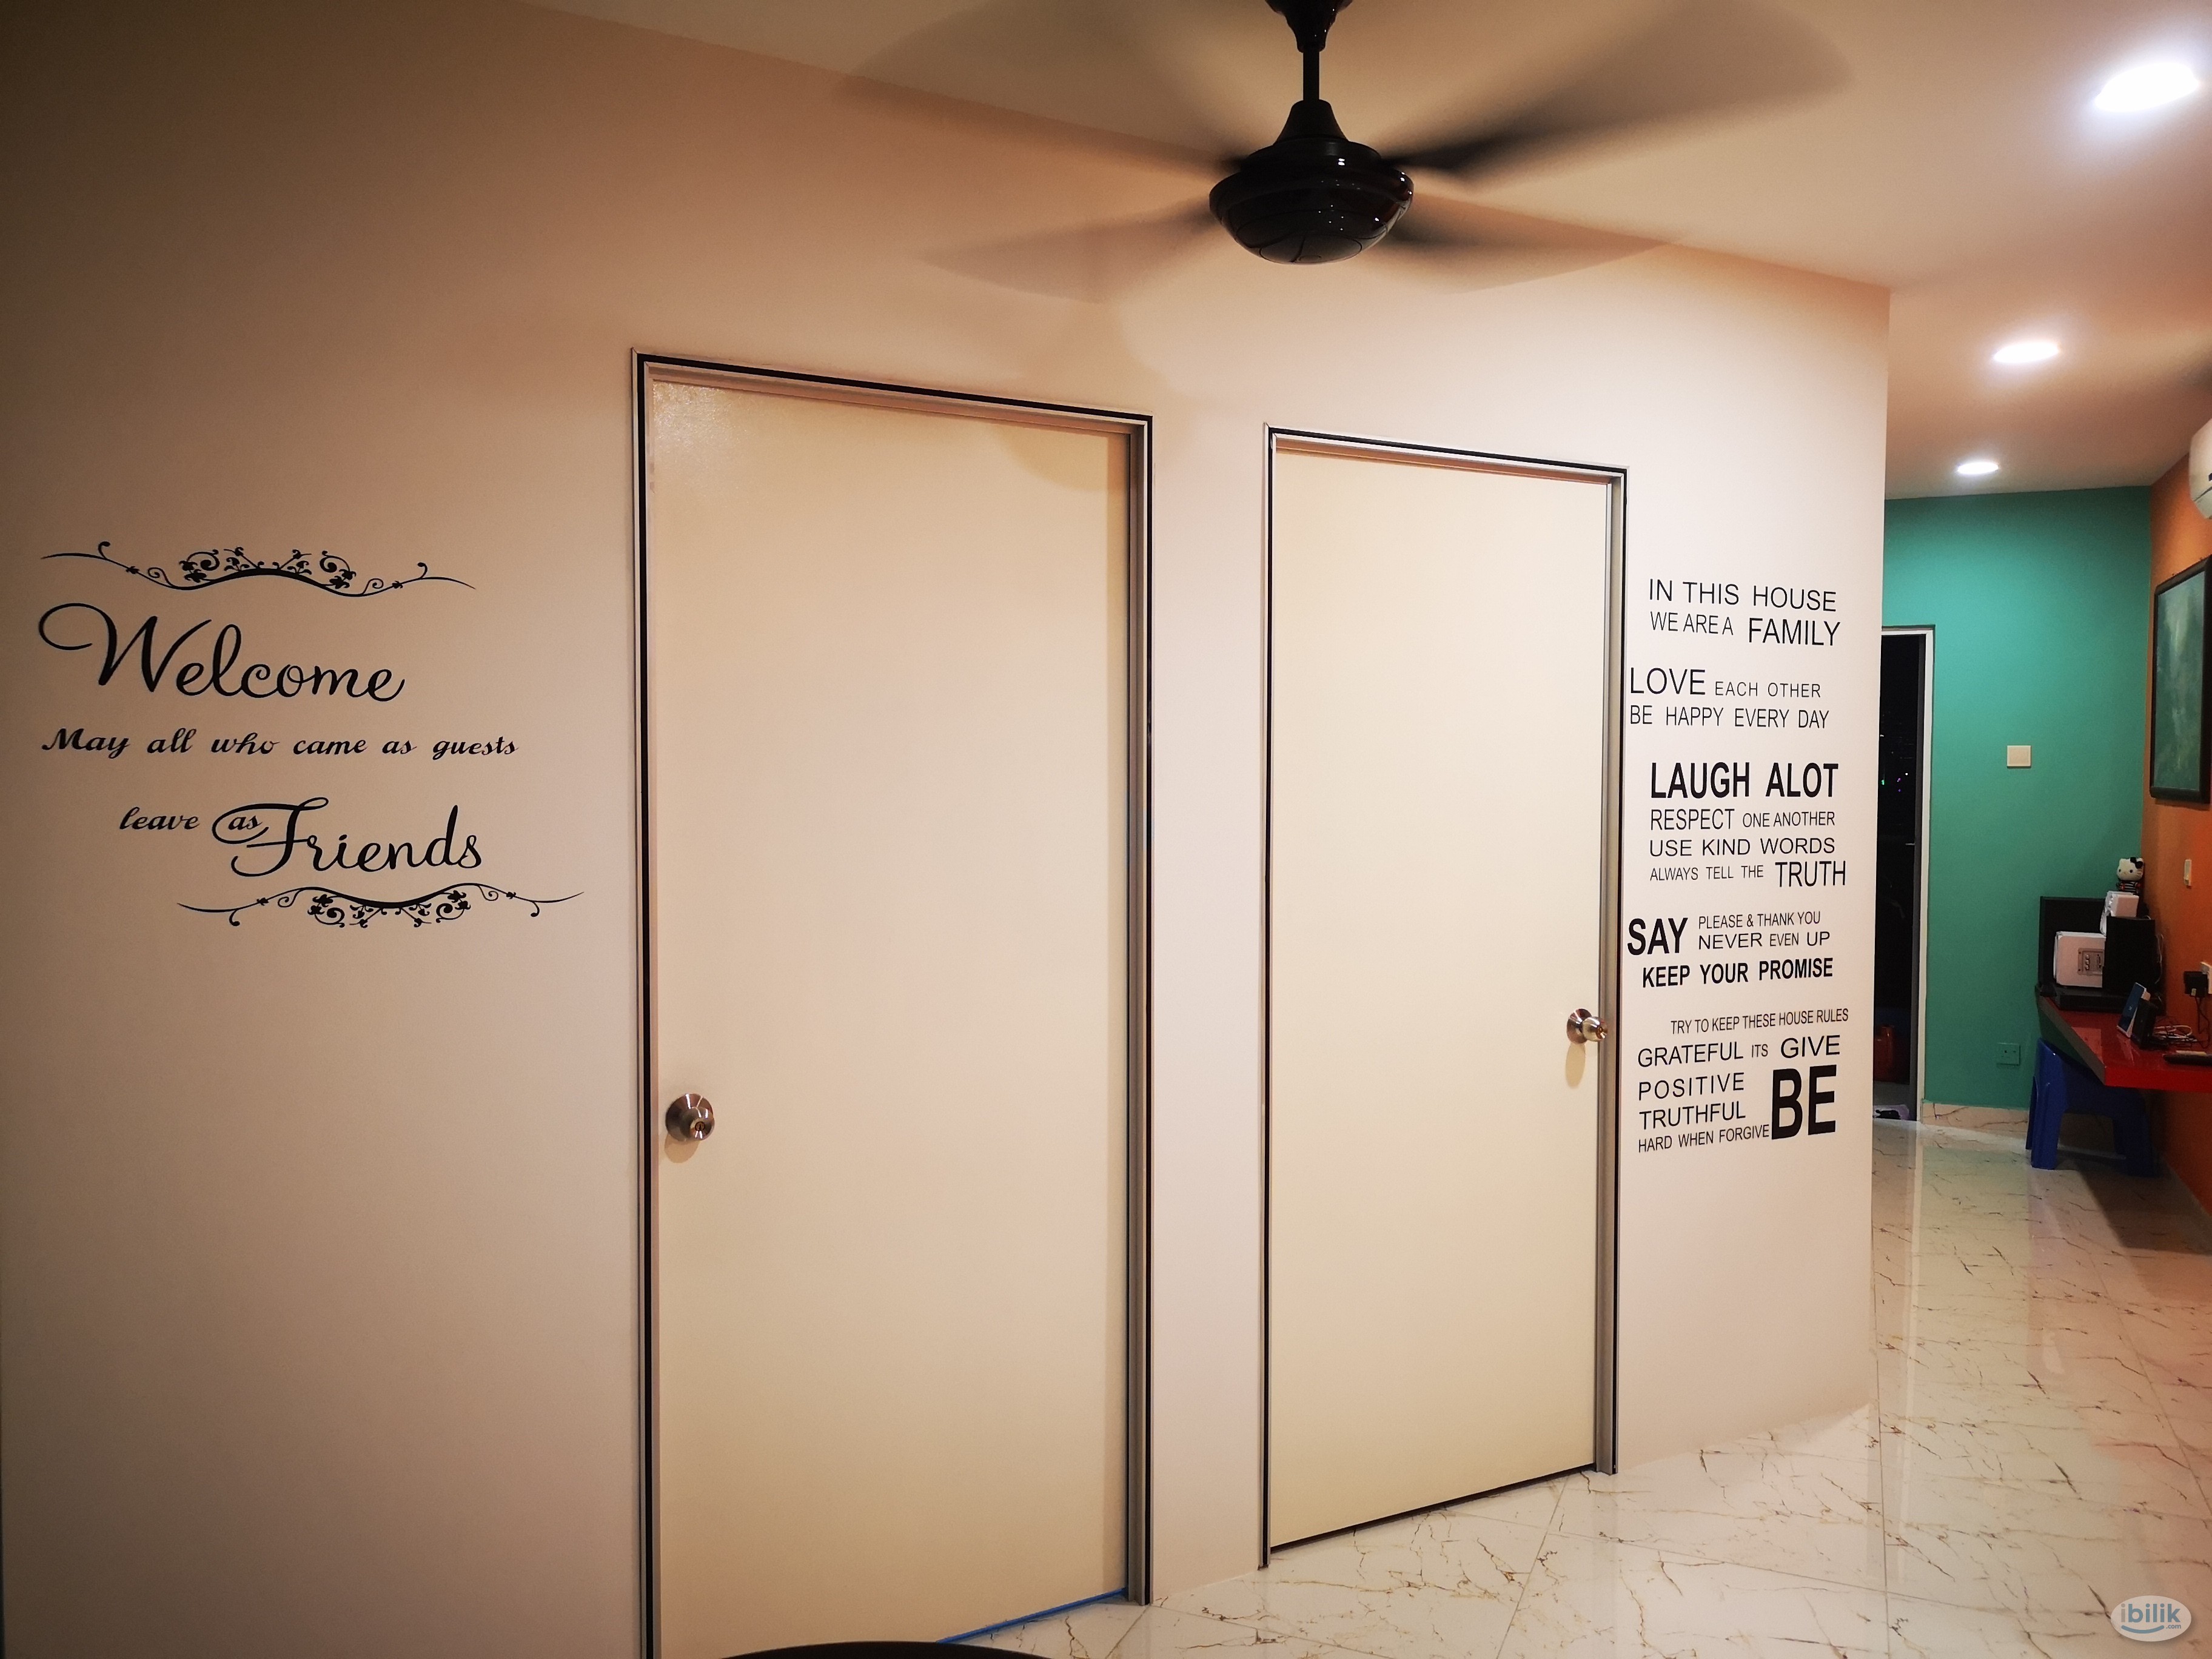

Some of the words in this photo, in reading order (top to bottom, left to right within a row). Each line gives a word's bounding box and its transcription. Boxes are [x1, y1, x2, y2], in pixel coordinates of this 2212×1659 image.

[1650, 578, 1672, 601] IN
[1683, 581, 1738, 605] THIS
[1754, 586, 1836, 612] HOUSE
[1651, 611, 1678, 631] WE
[1683, 614, 1718, 634] ARE
[1722, 617, 1733, 635] A
[1749, 618, 1840, 646] FAMILY
[38, 603, 405, 702] Welcome
[1631, 668, 1705, 695] LOVE
[1715, 682, 1757, 696] EACH
[1768, 683, 1820, 697] OTHER
[1631, 705, 1652, 724] BE
[1666, 706, 1723, 726] HAPPY
[1735, 708, 1789, 728] EVERY
[1798, 710, 1829, 728] DAY
[41, 728, 130, 759] May
[147, 728, 197, 754] all
[211, 732, 279, 755] who
[293, 740, 368, 755] came
[382, 740, 417, 754] as
[432, 736, 518, 760] guests
[1651, 762, 1749, 799] LAUGH
[1766, 763, 1838, 797] ALOT
[119, 806, 200, 830] leave
[229, 813, 261, 831] as
[1651, 809, 1735, 830] RESPECT
[1743, 813, 1770, 828] ONE
[1774, 811, 1835, 826] ANOTHER
[211, 797, 481, 877] Friends
[1651, 840, 1692, 857] USE
[1703, 839, 1750, 856] KIND
[1760, 837, 1834, 854] WORDS
[1650, 867, 1698, 881] ALWAYS
[1706, 866, 1734, 879] TELL
[1741, 865, 1763, 878] THE
[1775, 860, 1846, 887] TRUTH
[1699, 914, 1743, 929] PLEASE
[1747, 914, 1754, 927] &
[1757, 913, 1794, 927] THANK
[1797, 911, 1820, 925] YOU
[1627, 917, 1688, 955] SAY
[1699, 933, 1762, 950] NEVER
[1770, 933, 1798, 947] EVEN
[1807, 931, 1830, 946] UP
[1643, 965, 1690, 988] KEEP
[1700, 963, 1748, 984] YOUR
[1759, 957, 1833, 980] PROMISE
[1671, 1020, 1692, 1034] TRY
[1695, 1019, 1709, 1033] TO
[1712, 1016, 1740, 1031] KEEP
[1742, 1013, 1775, 1029] THESE
[1779, 1010, 1814, 1025] HOUSE
[1817, 1008, 1848, 1023] RULES
[1638, 1041, 1743, 1067] GRATEFUL
[1752, 1044, 1768, 1057] ITS
[1781, 1034, 1840, 1058] GIVE
[1639, 1072, 1744, 1101] POSITIVE
[1639, 1101, 1746, 1130] TRUTHFUL
[1772, 1064, 1837, 1140] BE
[1639, 1136, 1672, 1153] HARD
[1678, 1130, 1714, 1147] WHEN
[1720, 1124, 1769, 1143] FORGIVE
